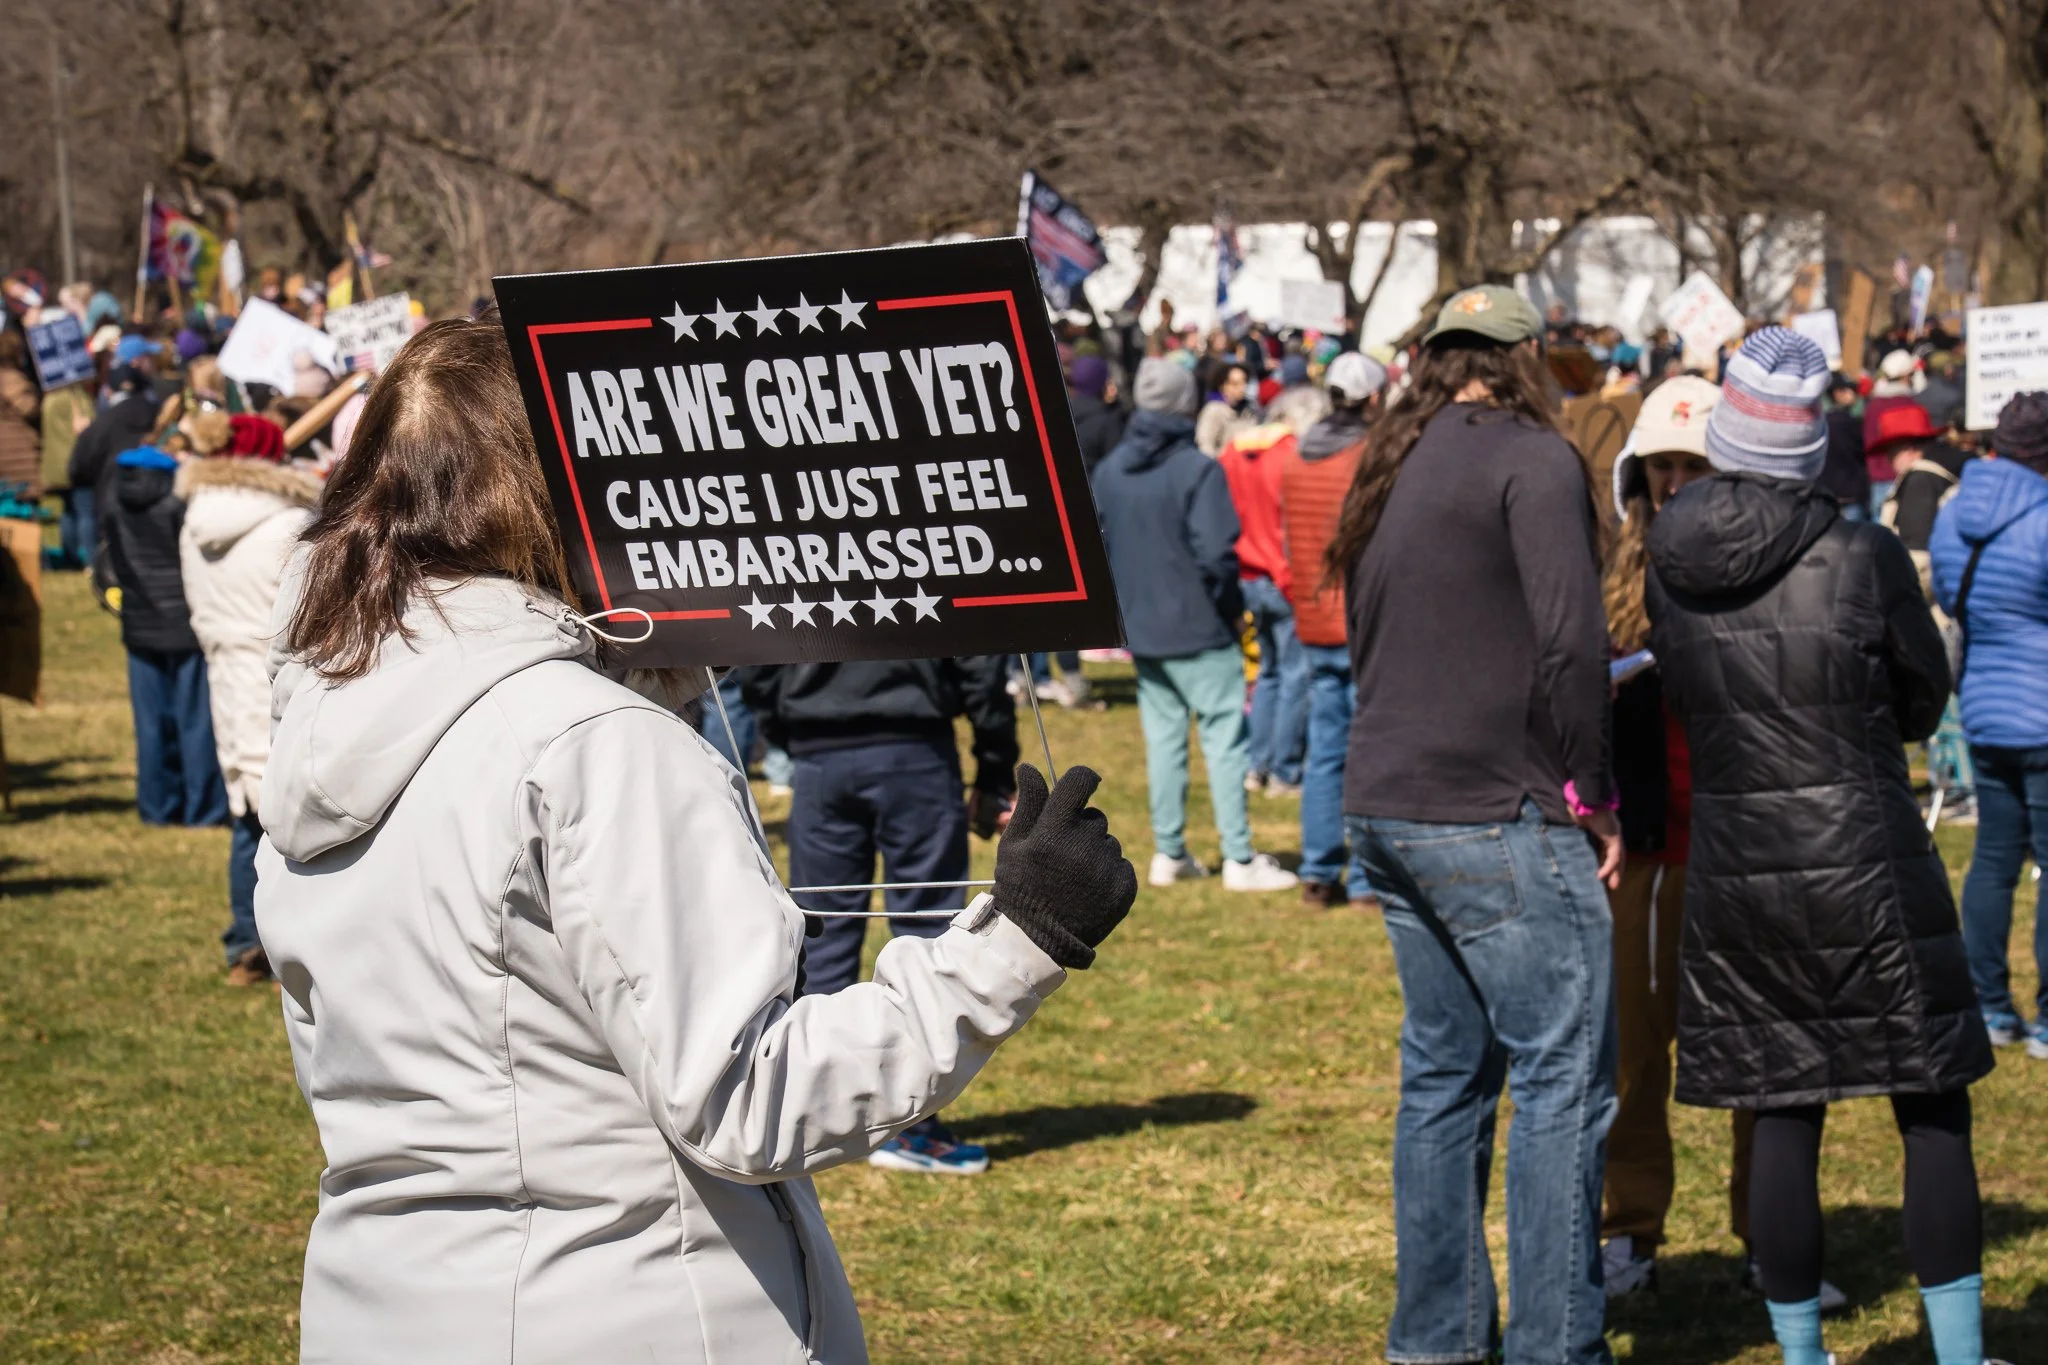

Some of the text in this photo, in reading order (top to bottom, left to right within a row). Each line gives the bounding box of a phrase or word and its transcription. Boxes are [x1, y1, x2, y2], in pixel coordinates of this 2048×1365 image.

[566, 340, 1021, 458] ARE WE GREAT YET?
[606, 458, 1028, 530] CAUSE I JUST FEEL
[625, 524, 1043, 591] EMBARRASSED...
